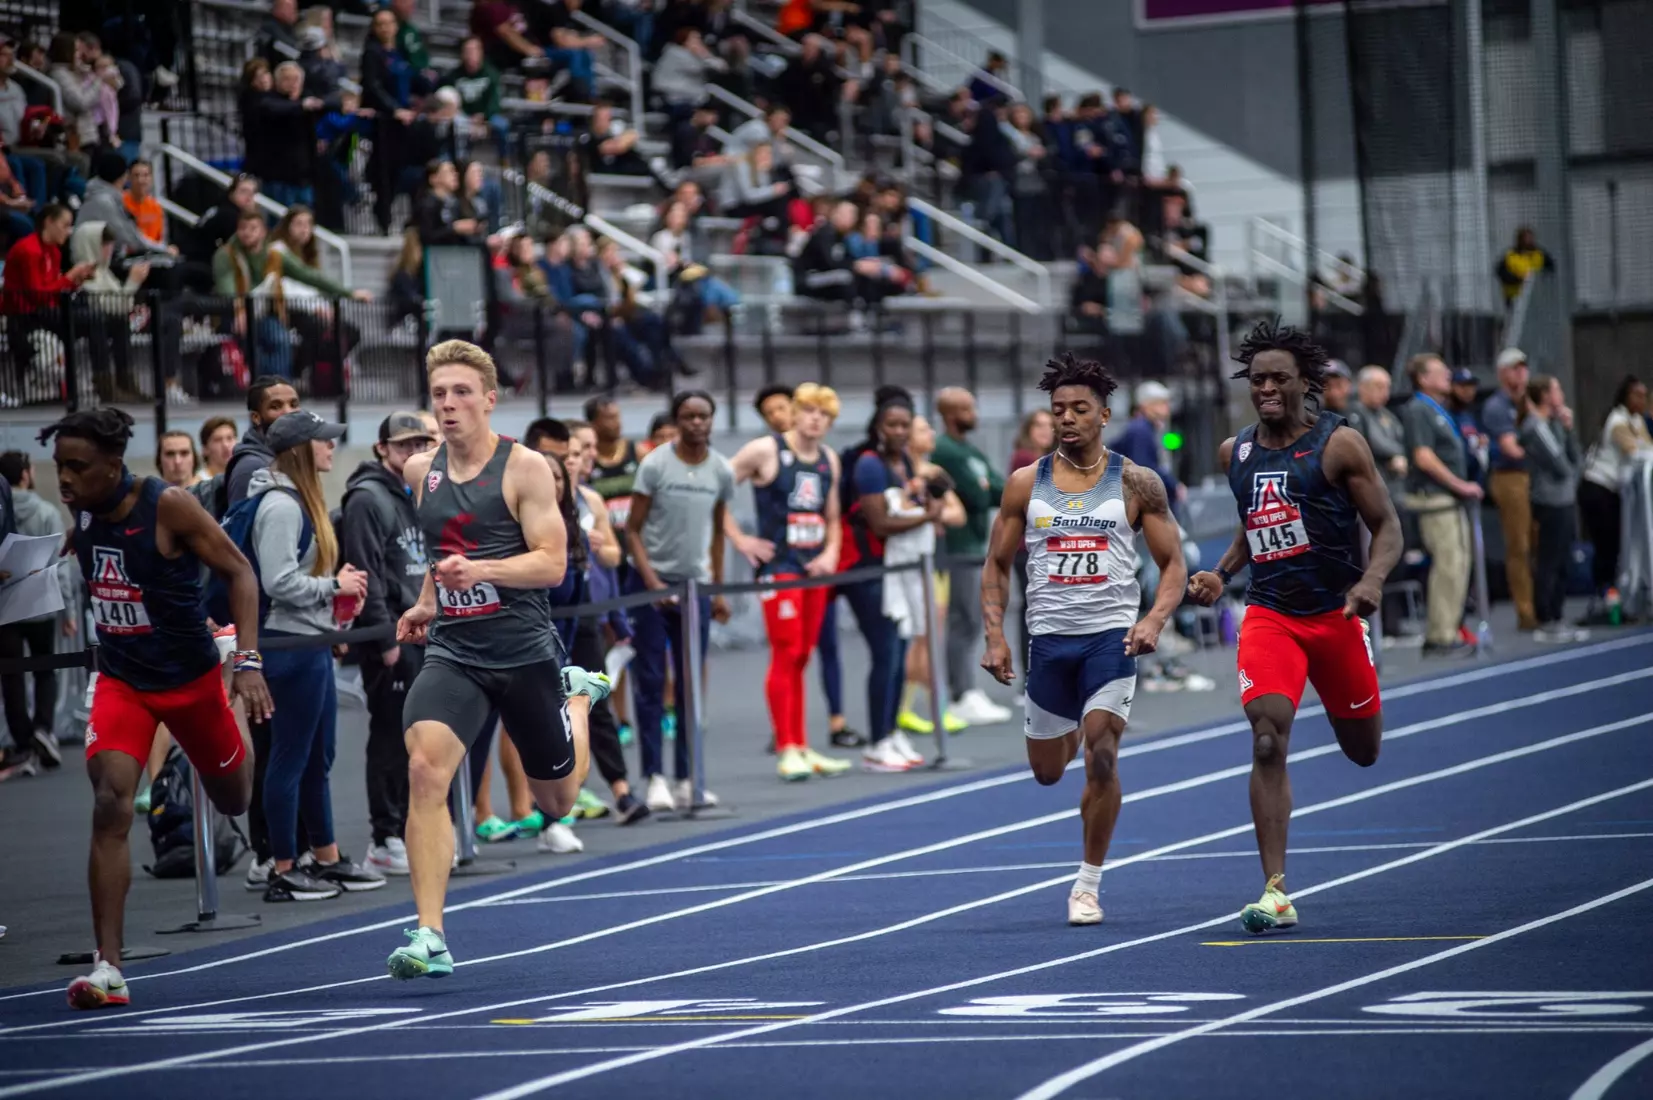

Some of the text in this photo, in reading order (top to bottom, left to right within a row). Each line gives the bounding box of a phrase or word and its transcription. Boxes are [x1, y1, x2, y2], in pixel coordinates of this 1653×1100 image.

[1077, 540, 1097, 549] OPEN
[1256, 522, 1298, 553] 145
[1056, 552, 1099, 576] 778
[447, 582, 488, 607] 885
[98, 601, 138, 626] 140
